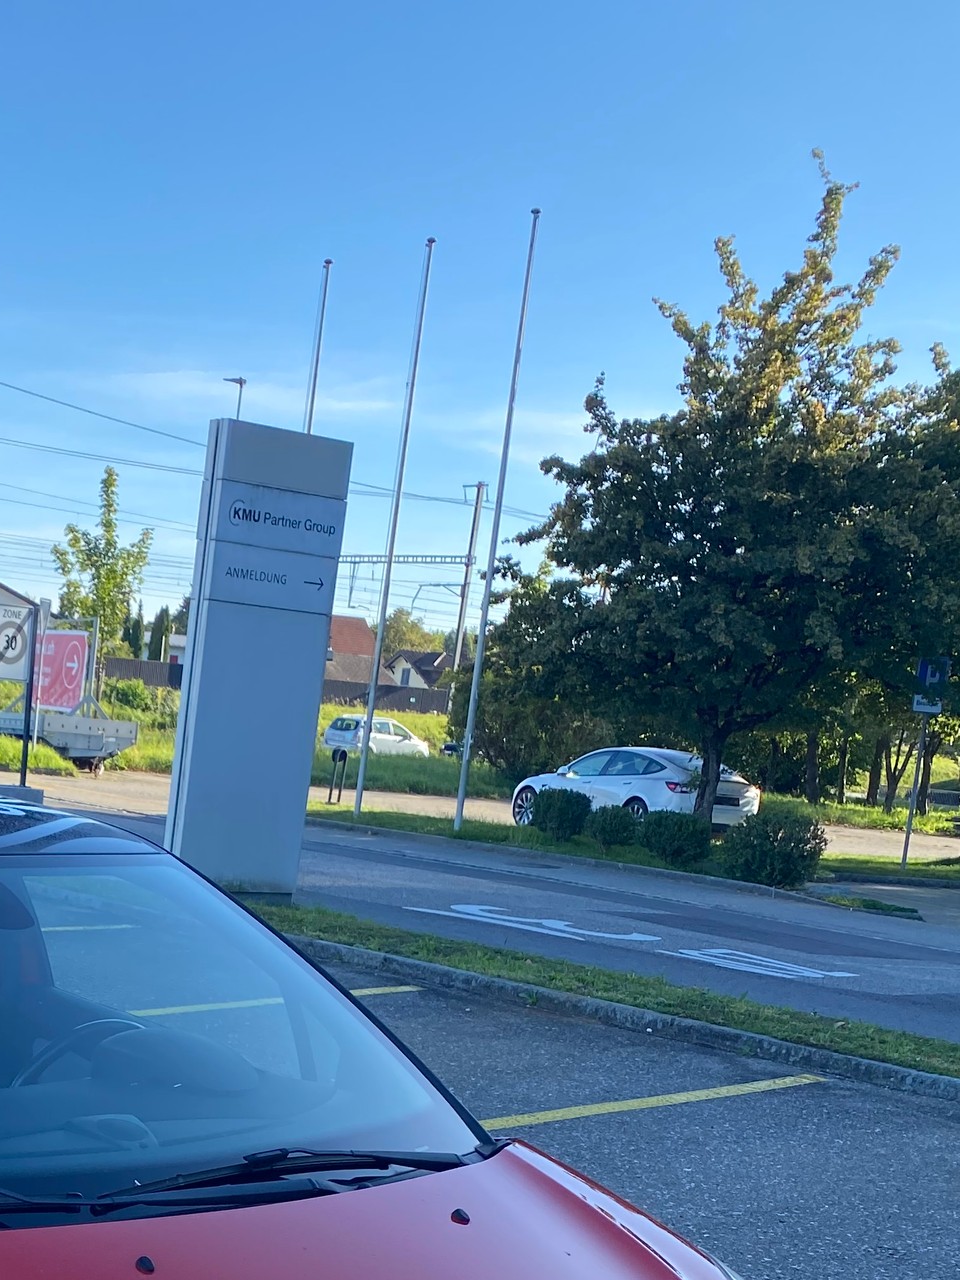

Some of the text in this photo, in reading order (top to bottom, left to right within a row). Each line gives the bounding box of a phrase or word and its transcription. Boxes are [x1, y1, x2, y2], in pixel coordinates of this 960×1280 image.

[233, 507, 336, 536] KMU Partner Group
[225, 566, 288, 585] ANMELDUNG
[3, 609, 22, 620] ZONE
[4, 634, 17, 650] 30
